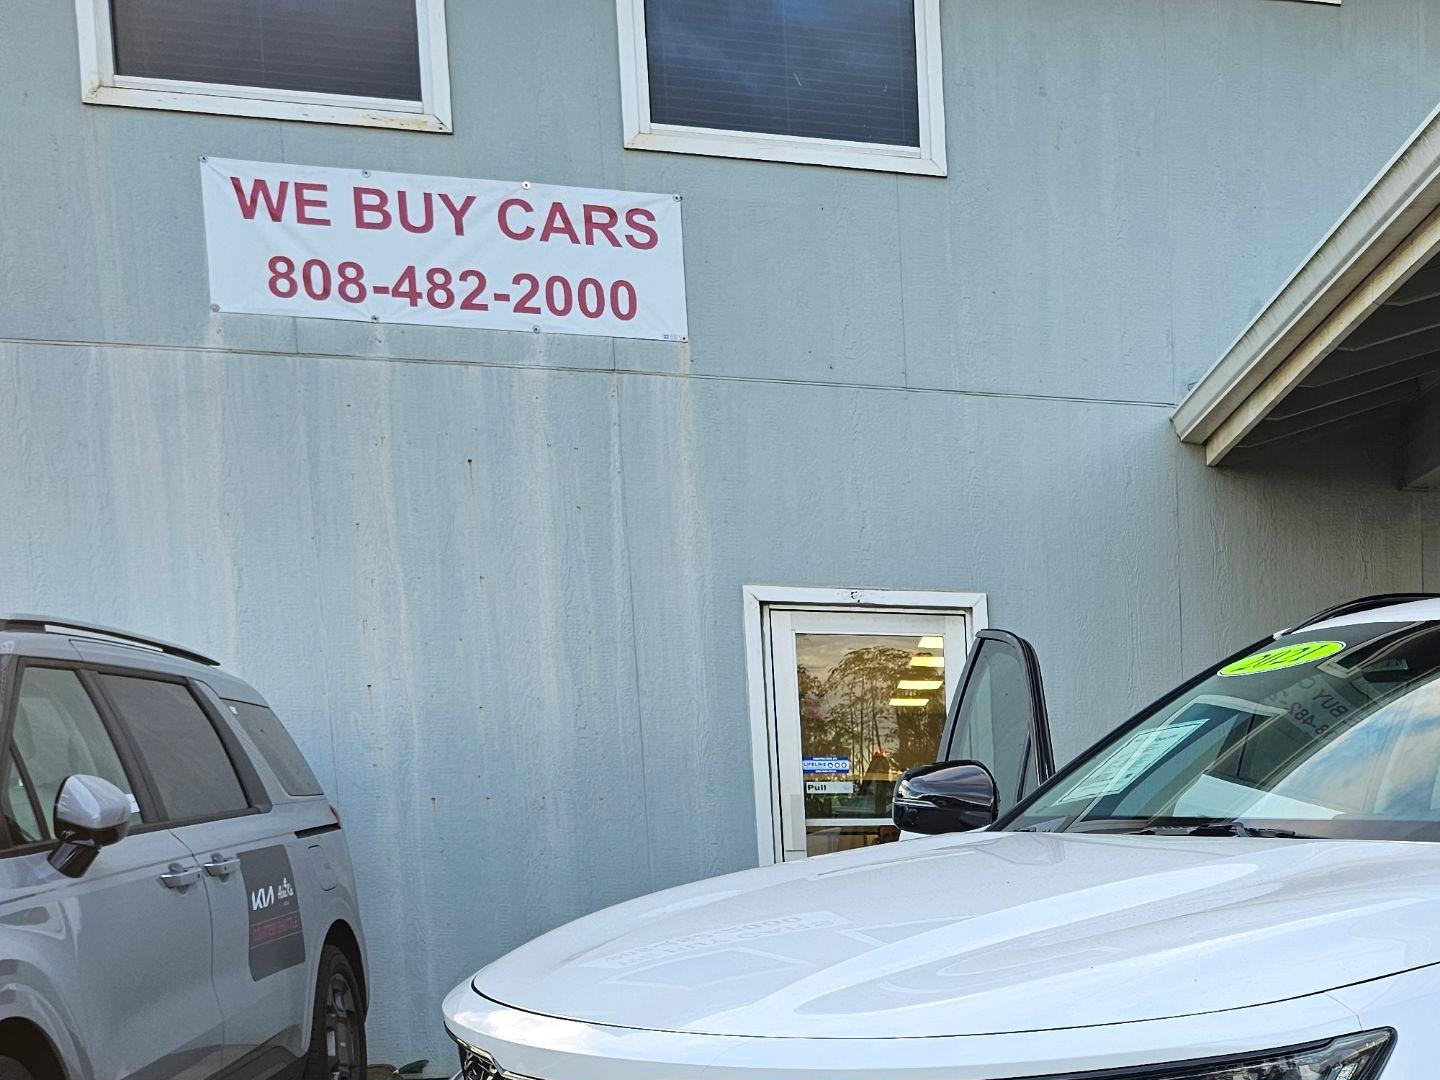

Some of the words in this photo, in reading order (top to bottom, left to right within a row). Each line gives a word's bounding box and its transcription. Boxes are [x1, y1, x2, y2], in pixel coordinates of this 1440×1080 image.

[230, 176, 331, 226] WE
[353, 186, 476, 236] BUY
[497, 198, 659, 250] CARS
[268, 255, 638, 321] 808-482-2000
